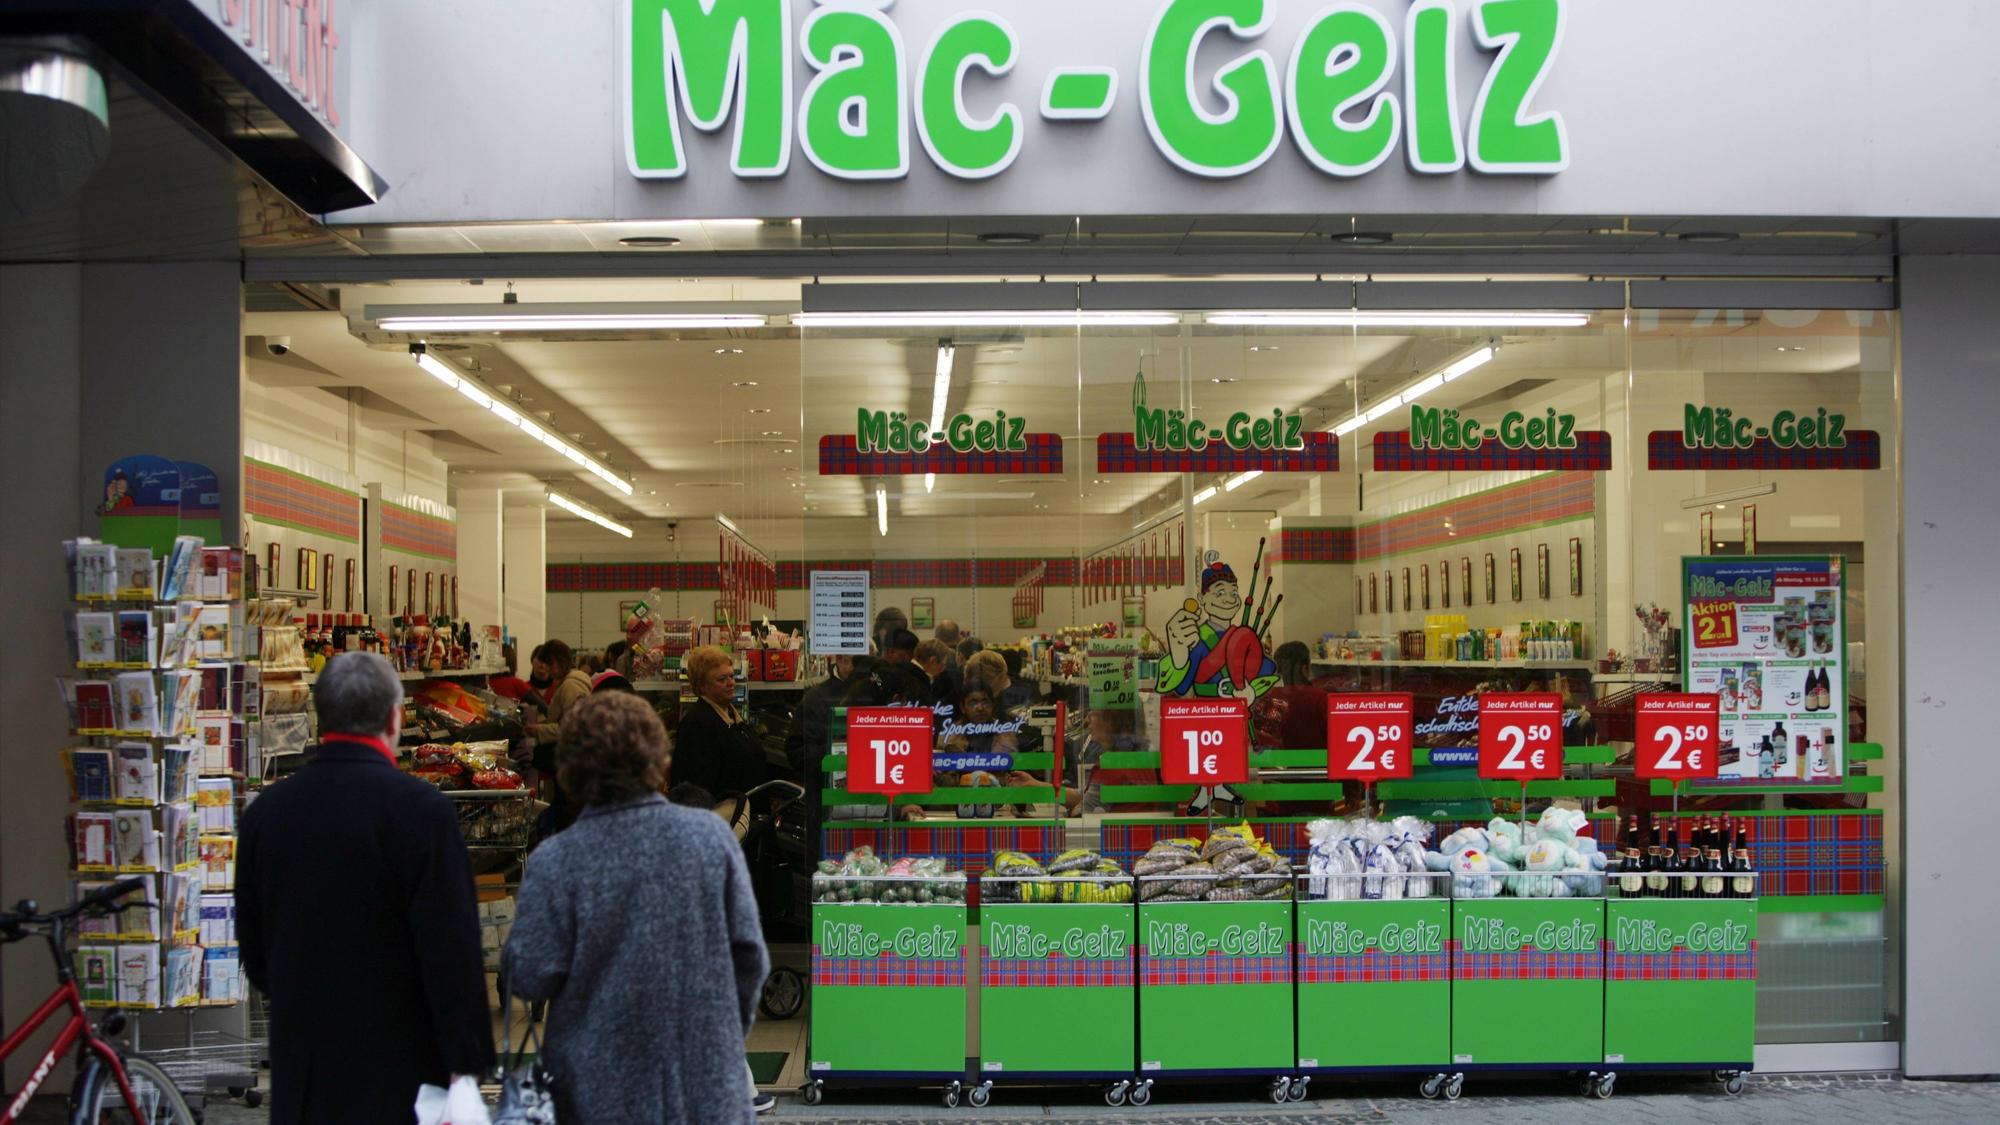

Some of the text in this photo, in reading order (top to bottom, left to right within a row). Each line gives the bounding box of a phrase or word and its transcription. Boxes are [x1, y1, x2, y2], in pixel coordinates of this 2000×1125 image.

[857, 407, 1026, 453] Mäc-Geiz
[1135, 405, 1303, 451] Mäc-Geiz
[1410, 403, 1576, 451] Mäc-Geiz
[1684, 403, 1847, 450] Mäc-Geiz
[1690, 574, 1773, 598] Mäc-Geiz
[1691, 600, 1736, 616] Aktion
[856, 714, 924, 725] Jeder Artikel nur
[1167, 704, 1237, 716] Jeder Artikel nur
[1335, 700, 1404, 711] Jeder Artikel nur
[1438, 696, 1478, 716] Entde
[1486, 700, 1554, 710] Jeder Artikel nur
[1643, 700, 1711, 710] Jeder Artikel nur
[821, 919, 958, 958] Mäc-Geiz
[989, 920, 1126, 959] Mäc-Geiz
[1147, 920, 1285, 958] Mäc-Geiz
[1306, 918, 1442, 956] Mäc-Geiz
[1464, 915, 1598, 953] Mäc-Geiz
[1616, 915, 1748, 953] Mäc-Geiz
[8, 1049, 56, 1120] GIANT
